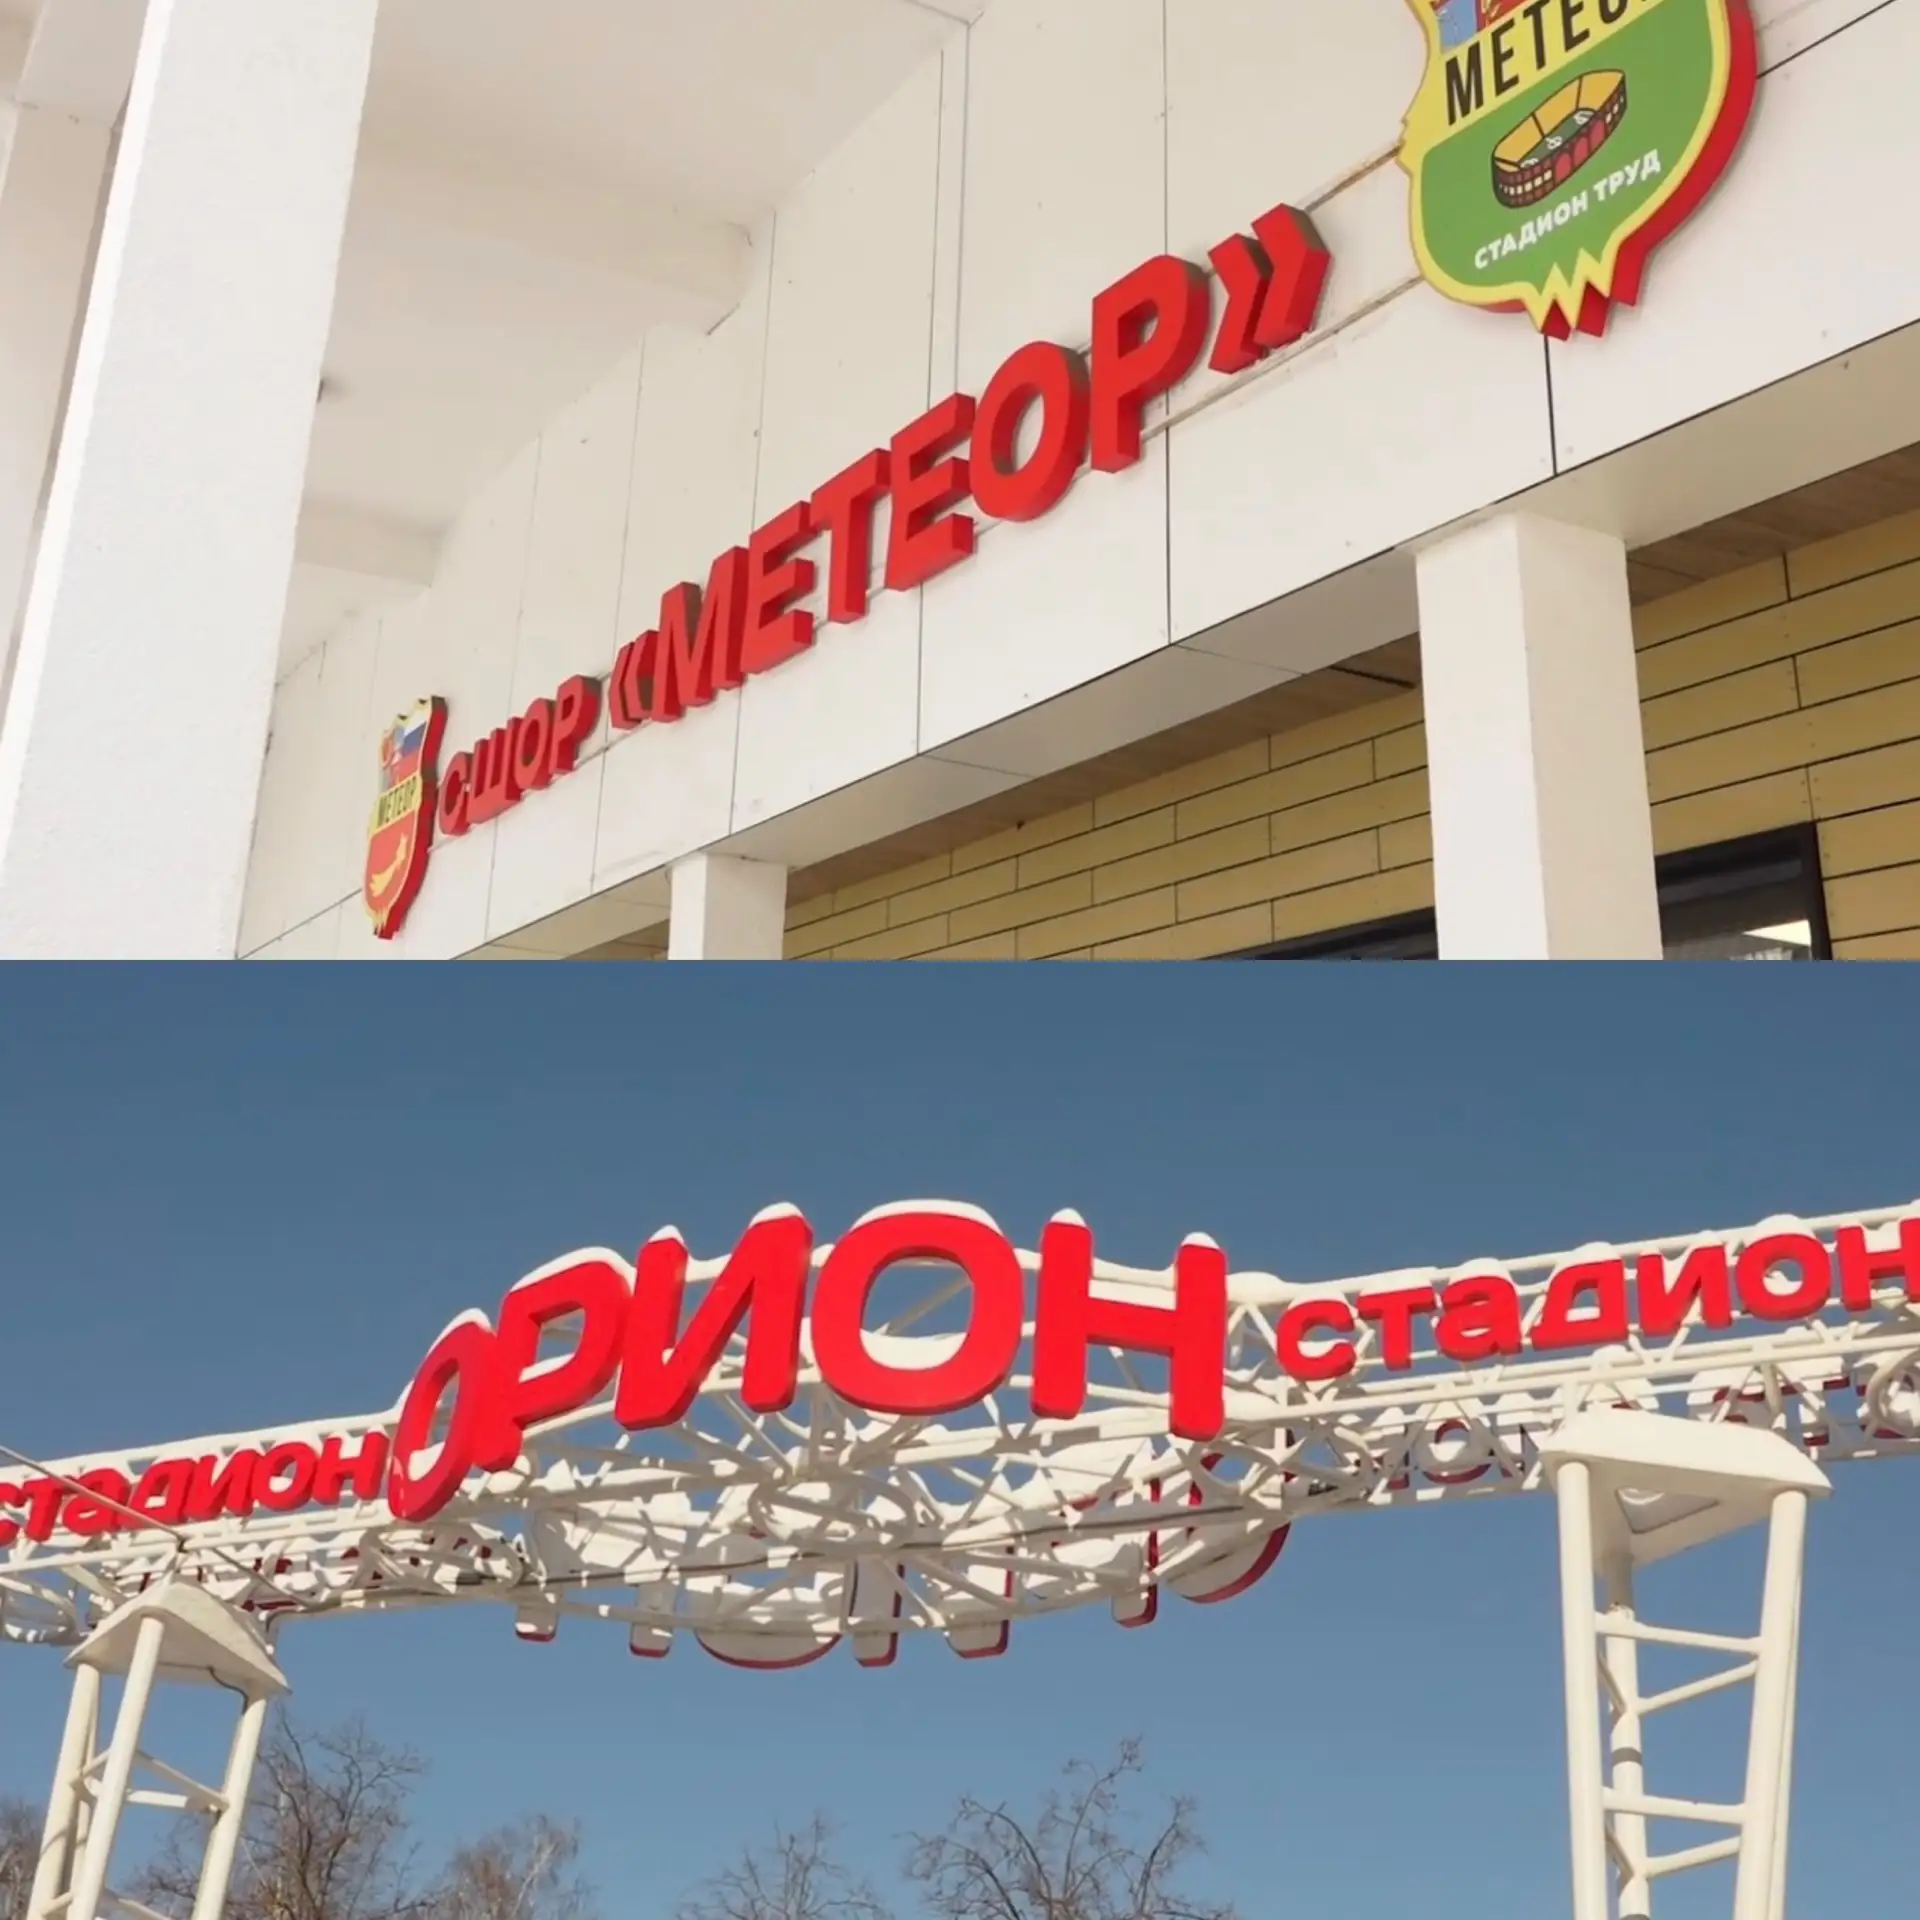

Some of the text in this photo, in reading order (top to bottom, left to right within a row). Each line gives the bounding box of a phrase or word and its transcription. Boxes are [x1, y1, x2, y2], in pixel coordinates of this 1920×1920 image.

[1474, 149, 1661, 269] СТАДИОН ТРУД
[439, 204, 1331, 836] СШОР «МЕТЕОР»
[386, 1209, 1229, 1522] ОРИОН
